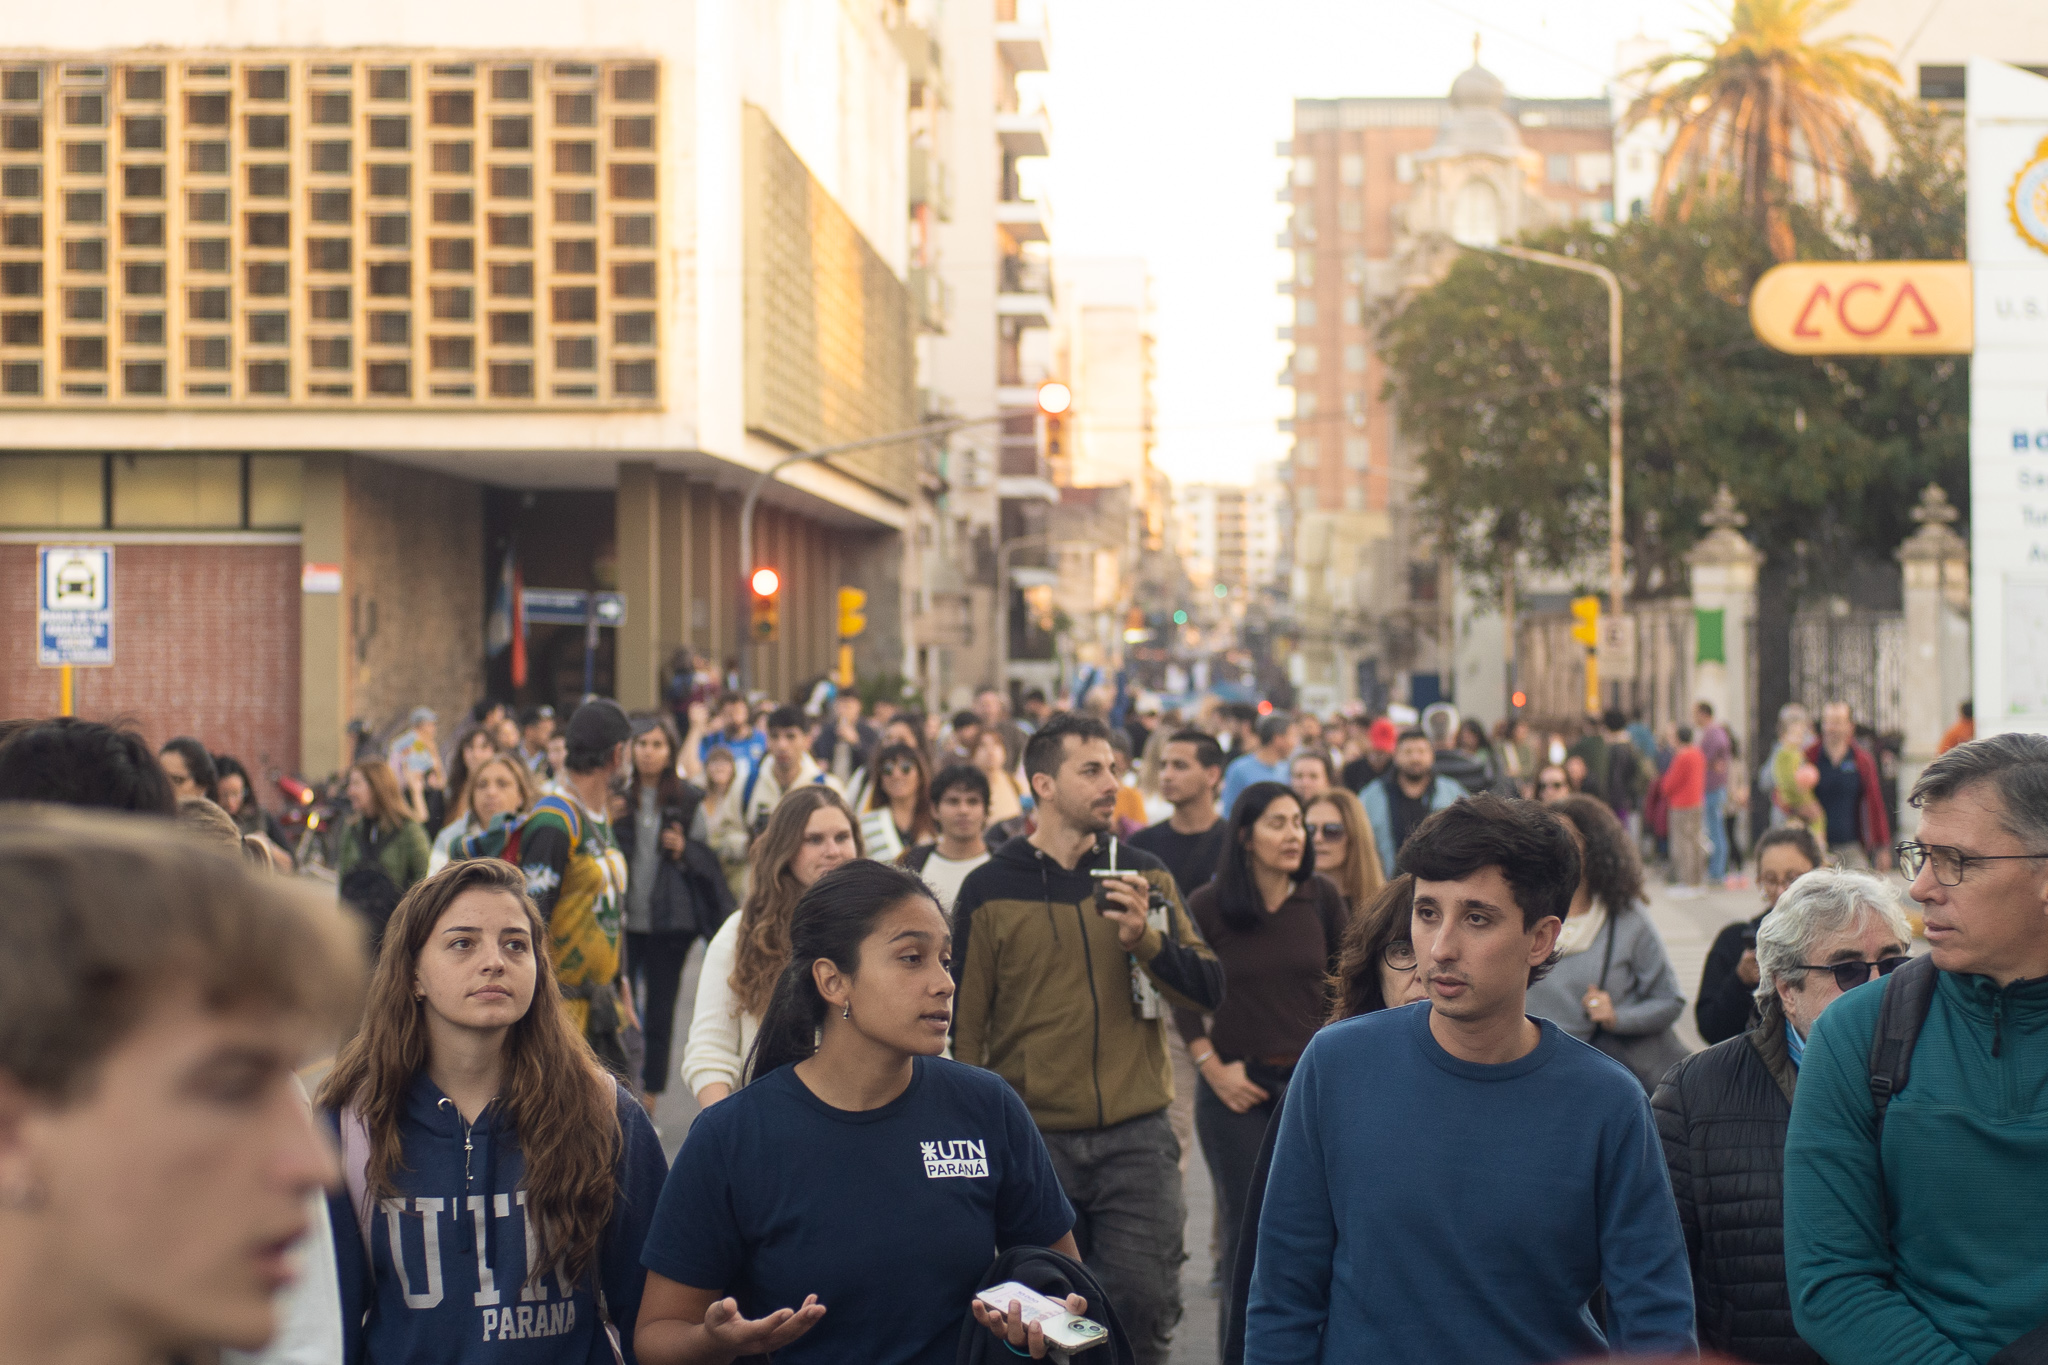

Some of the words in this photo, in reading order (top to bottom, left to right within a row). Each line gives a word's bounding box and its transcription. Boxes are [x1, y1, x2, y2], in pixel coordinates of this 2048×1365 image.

[1792, 281, 1940, 337] ACA
[937, 1139, 986, 1160] UTN
[927, 1160, 985, 1176] PARANÁ
[482, 1301, 576, 1341] PARANA
